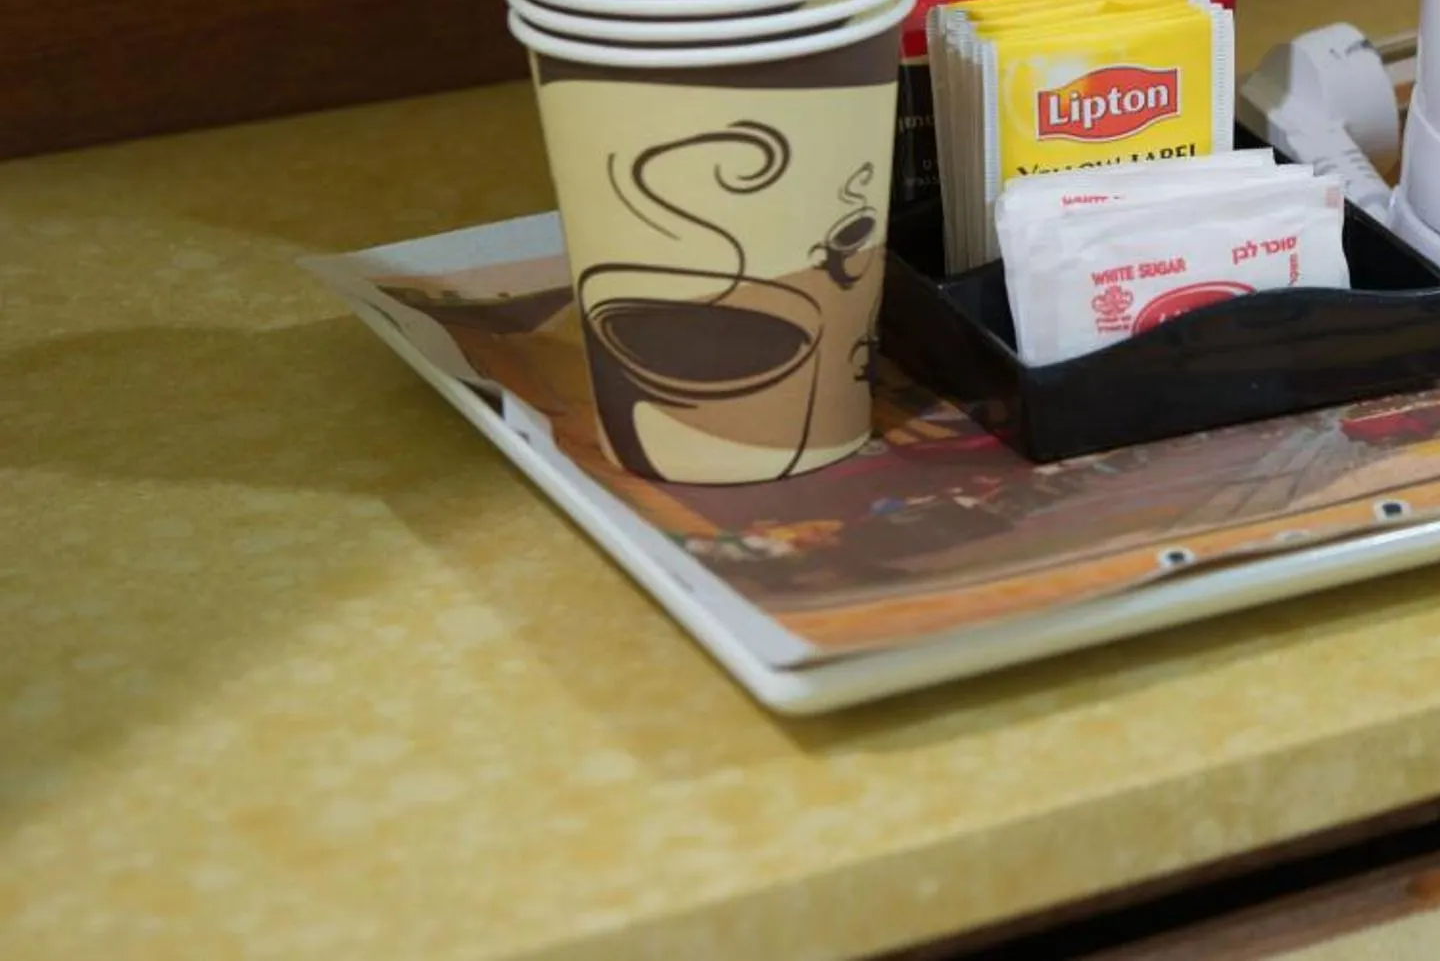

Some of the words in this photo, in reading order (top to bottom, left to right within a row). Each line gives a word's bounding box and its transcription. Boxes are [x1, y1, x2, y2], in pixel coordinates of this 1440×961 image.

[1049, 84, 1169, 130] Lipton
[1231, 240, 1258, 265] לבן
[1259, 236, 1297, 255] סוכר
[1091, 265, 1134, 286] WHITE
[1138, 257, 1186, 278] SUGAR
